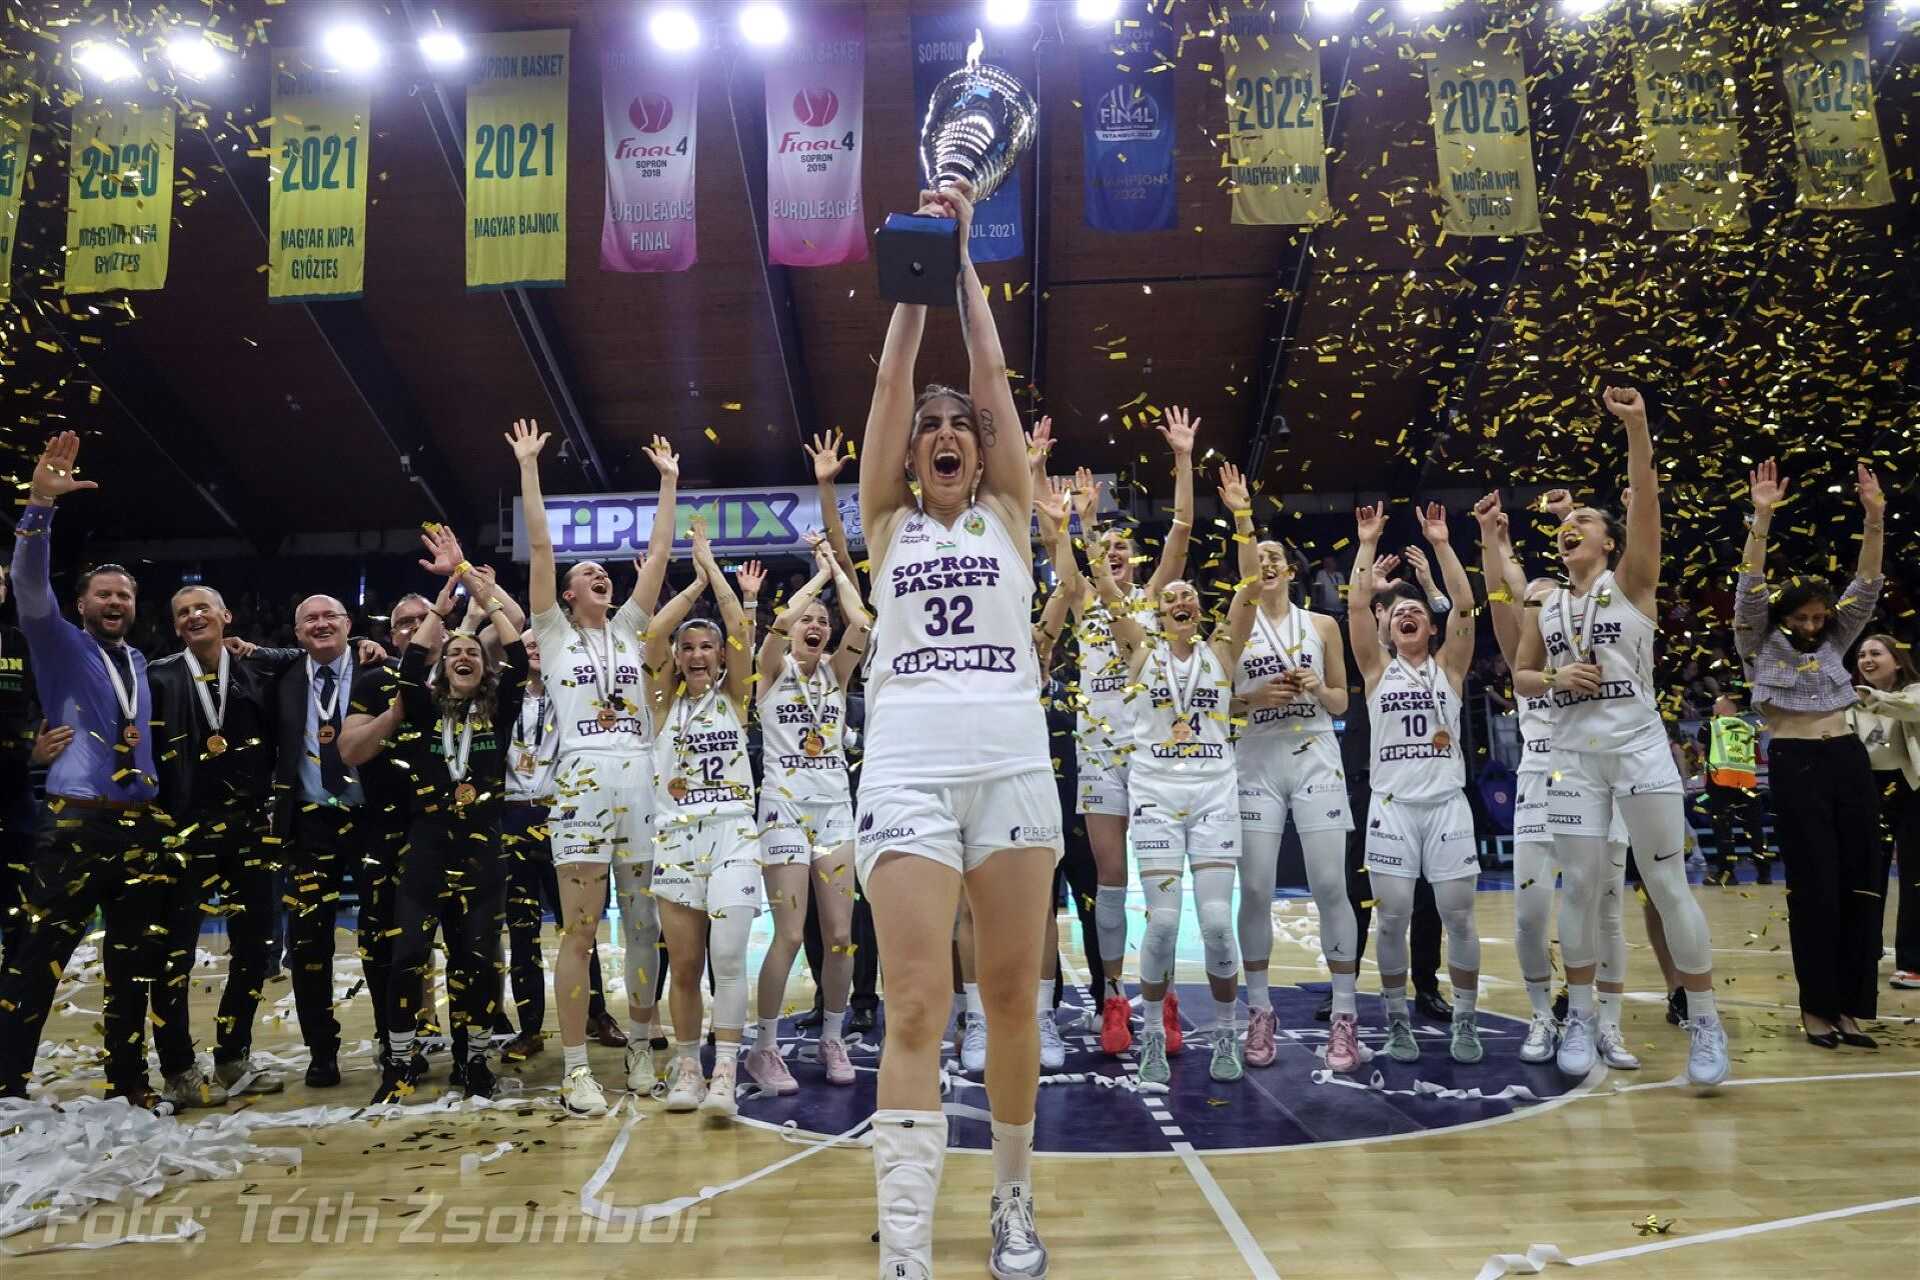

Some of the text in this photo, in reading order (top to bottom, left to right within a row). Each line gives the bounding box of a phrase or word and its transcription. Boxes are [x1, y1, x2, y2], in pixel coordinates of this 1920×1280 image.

[521, 54, 564, 77] BASKET
[1235, 76, 1314, 131] 2022
[1440, 78, 1519, 135] 2023
[281, 135, 359, 192] 2021
[474, 122, 555, 179] 2021
[800, 154, 833, 163] SOPRON
[78, 143, 161, 199] 2020
[636, 160, 667, 169] SOPRON
[280, 225, 356, 251] MAGYAR KUPA
[474, 212, 560, 240] MAGYAR BAJNOK
[989, 222, 1017, 238] 2021
[631, 231, 672, 252] FINAL
[892, 555, 1000, 583] SOPRON
[894, 571, 1000, 599] BASKET
[924, 595, 975, 637] 32
[1380, 691, 1447, 703] SOPRON
[1381, 701, 1447, 714] BASKET
[1401, 714, 1428, 738] 10
[698, 756, 725, 781] 12
